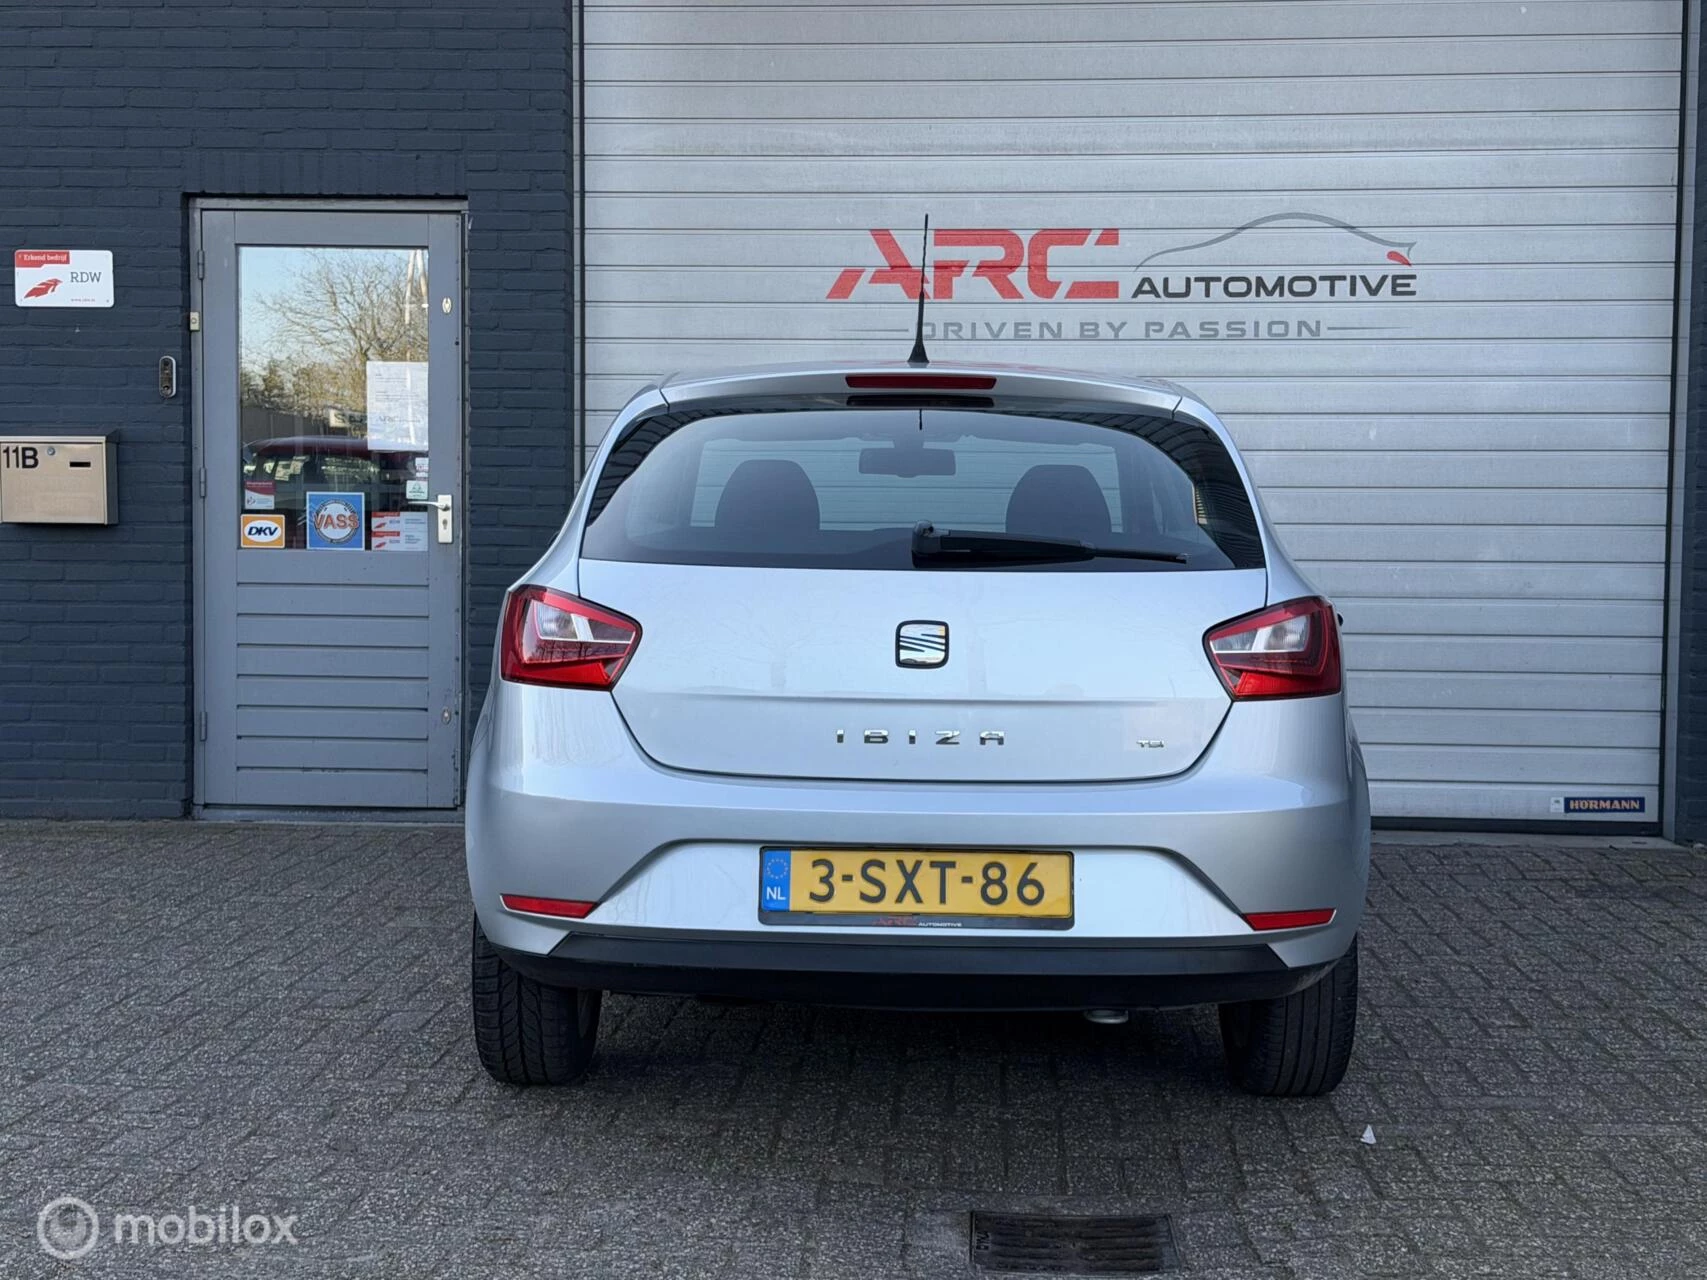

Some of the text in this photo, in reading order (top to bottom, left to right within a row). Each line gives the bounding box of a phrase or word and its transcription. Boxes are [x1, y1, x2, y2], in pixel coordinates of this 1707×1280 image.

[825, 228, 1417, 300] ARC AUTOMOTIVE
[70, 271, 102, 283] RDW
[921, 319, 1321, 339] DRIVEN BY PASSION
[2, 446, 39, 469] 11B
[247, 526, 278, 537] DKV
[836, 729, 1005, 746] IBIZA
[809, 857, 1046, 907] 3-SXT-86
[766, 886, 787, 901] NL
